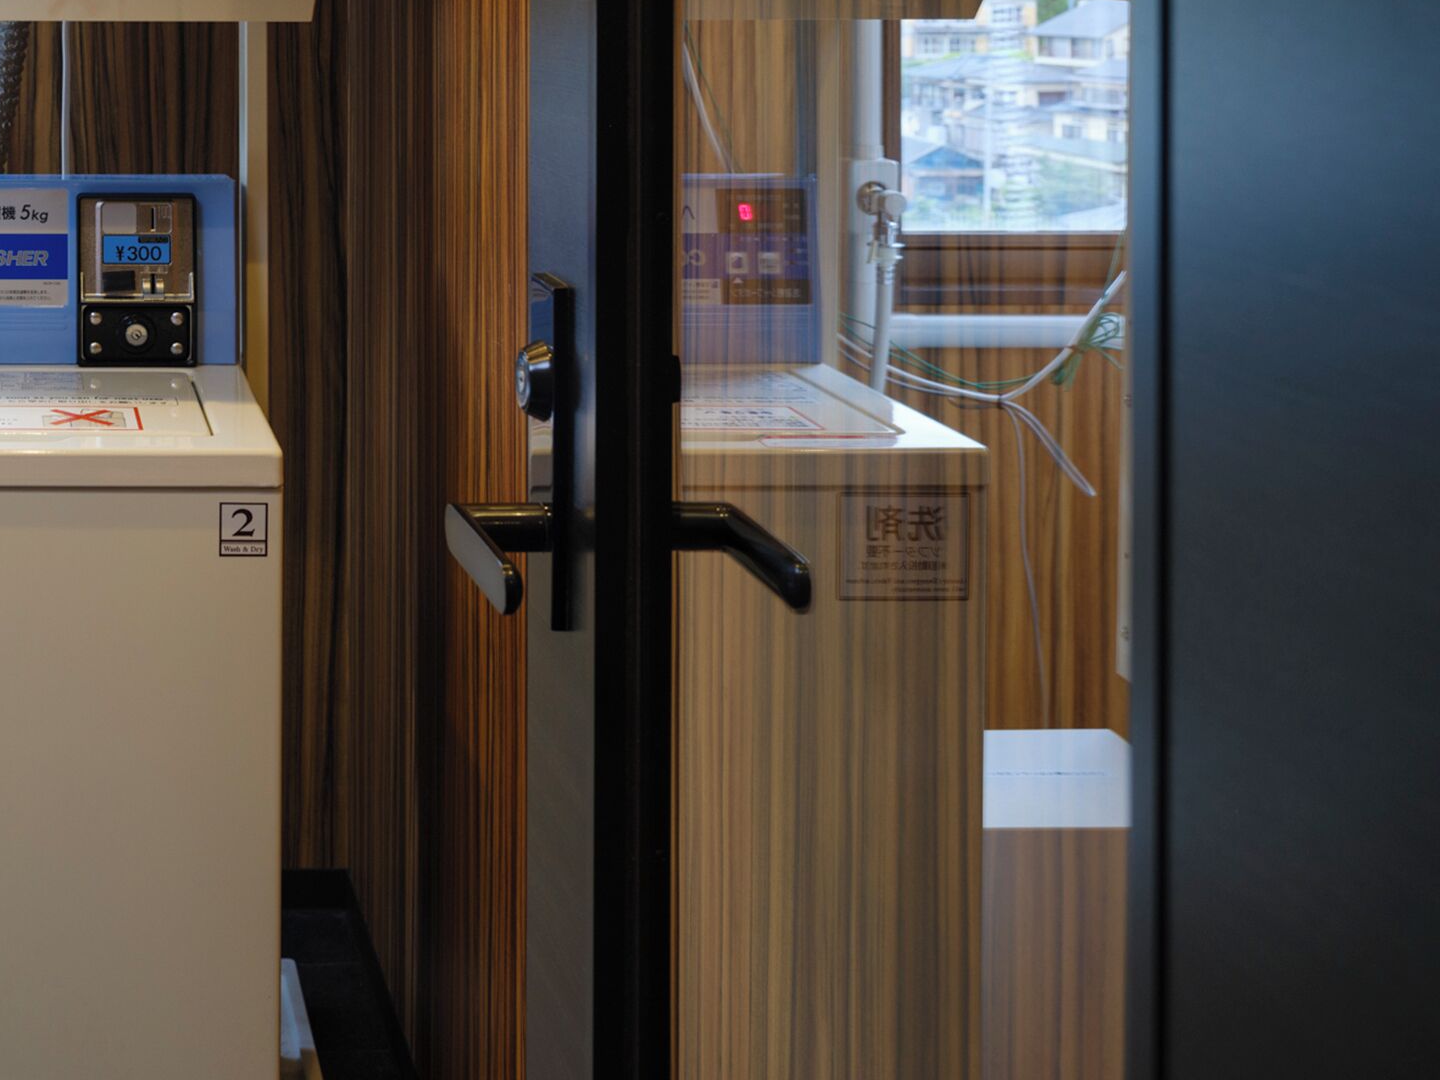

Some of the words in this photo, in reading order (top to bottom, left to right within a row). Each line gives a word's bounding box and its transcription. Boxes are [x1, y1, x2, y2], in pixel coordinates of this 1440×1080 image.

[20, 204, 49, 223] 5kg
[115, 245, 162, 262] ¥300
[231, 508, 255, 537] 2
